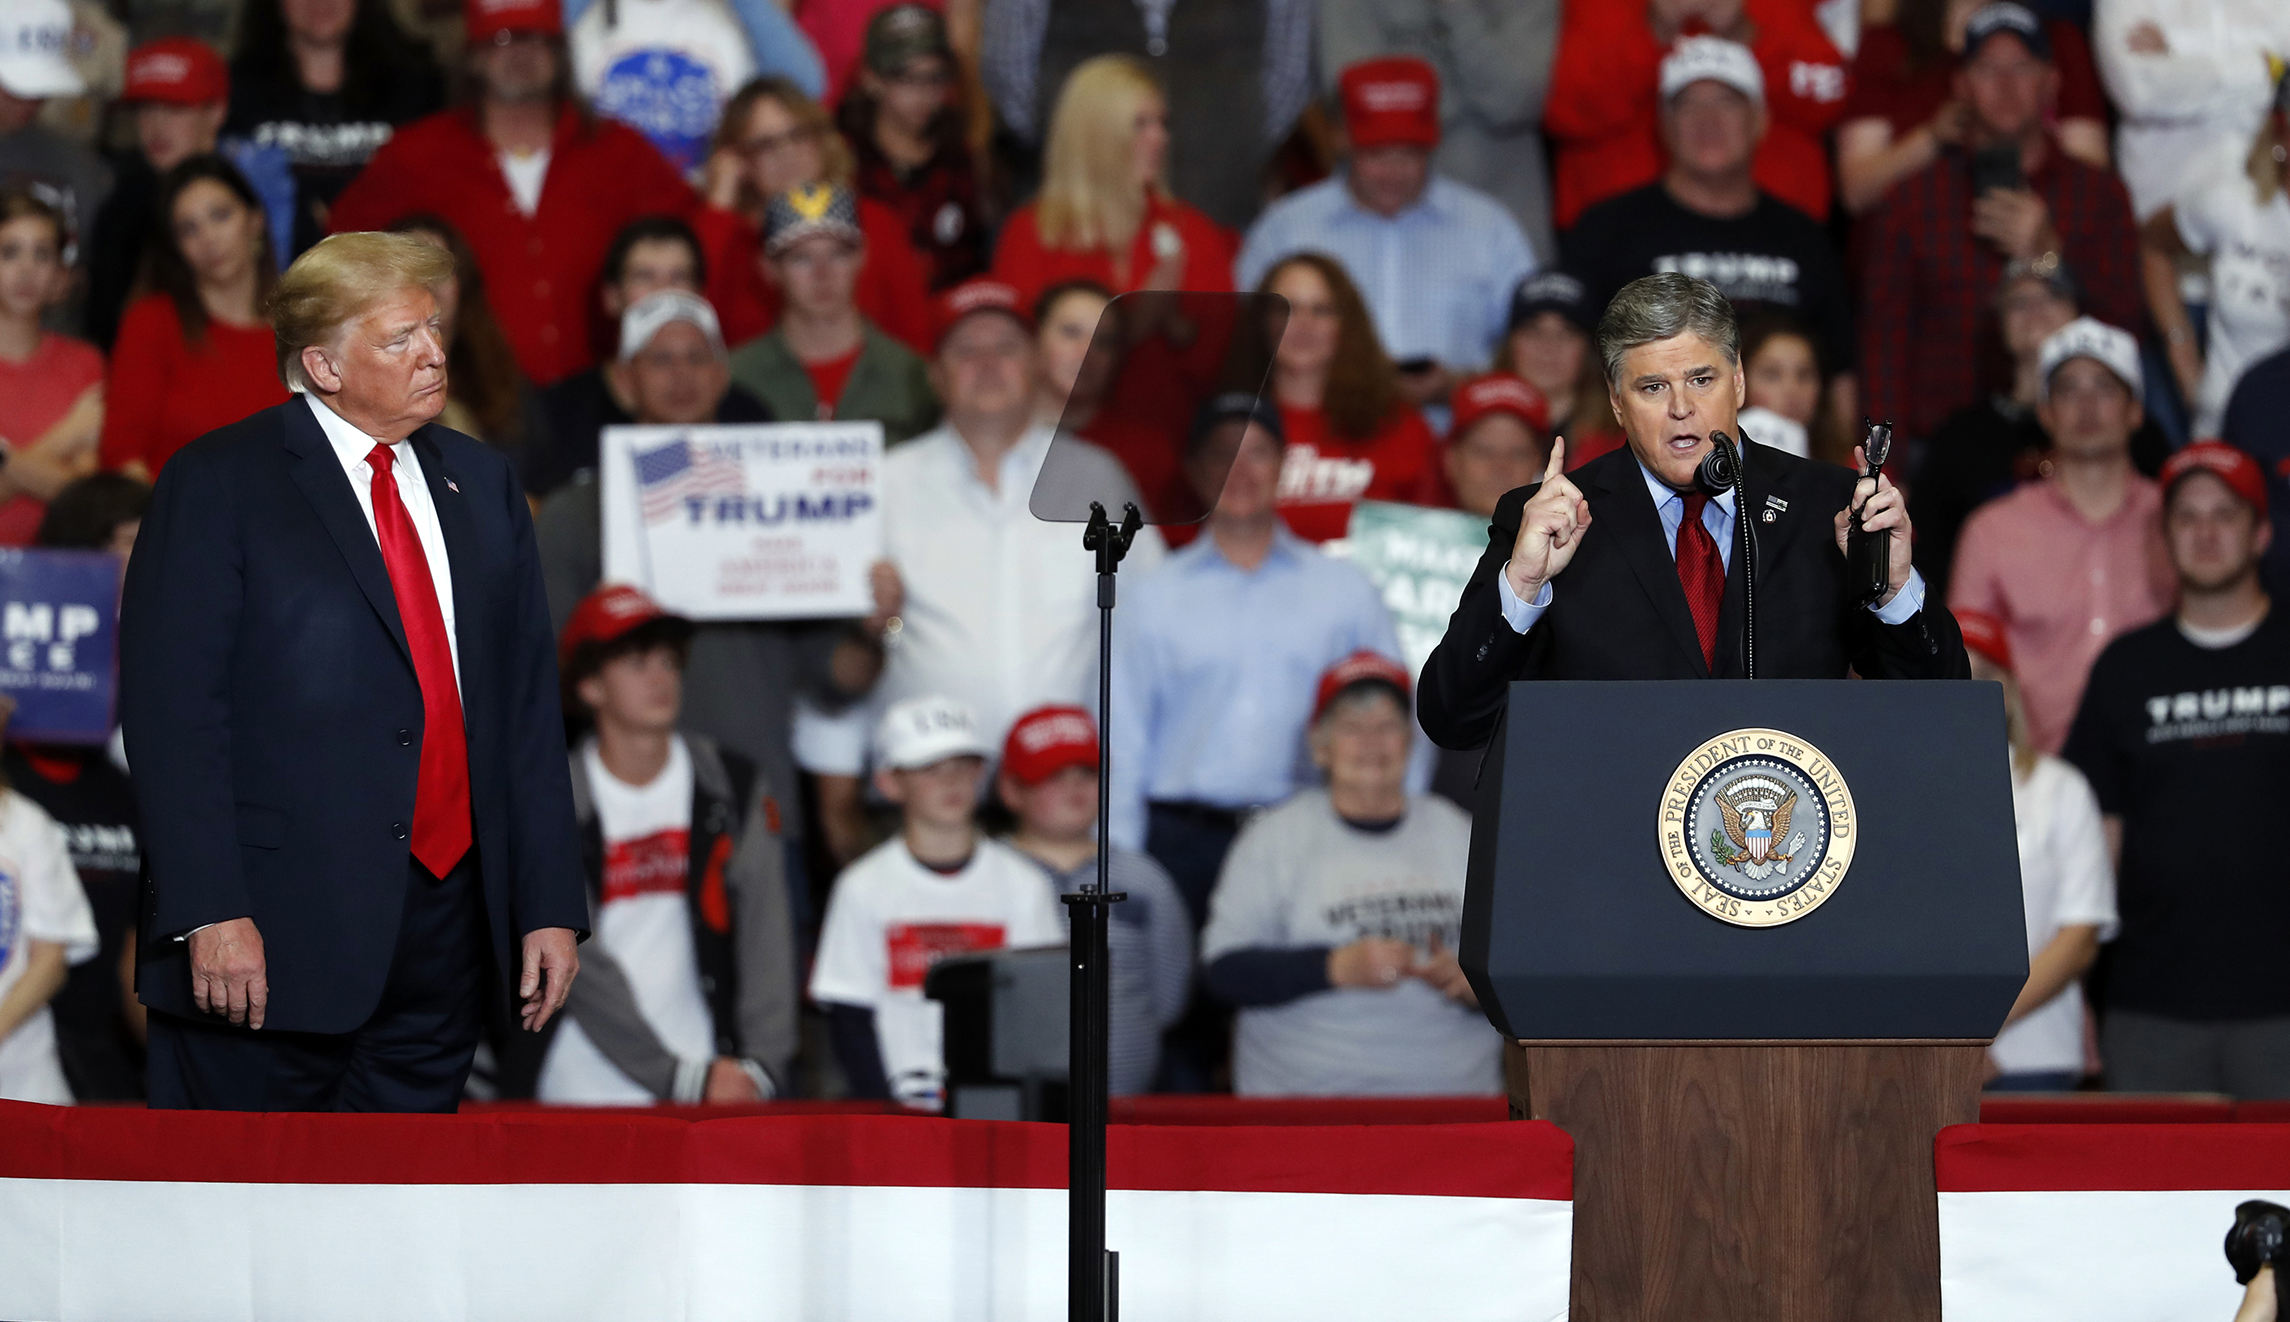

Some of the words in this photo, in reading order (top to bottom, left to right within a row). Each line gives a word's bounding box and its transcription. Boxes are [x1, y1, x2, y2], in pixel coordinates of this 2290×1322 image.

[1652, 253, 1799, 285] TRUMP
[685, 494, 873, 524] TRUMP
[2146, 685, 2290, 724] TRUMP
[1756, 737, 1776, 751] OF
[1779, 741, 1805, 761] THE
[1665, 736, 1751, 824] PRESIDENT
[1808, 758, 1850, 839] UNITED
[1668, 831, 1684, 858] THE
[1676, 861, 1692, 879] OF
[1691, 877, 1741, 917] SEAL
[1777, 857, 1842, 917] STATES
